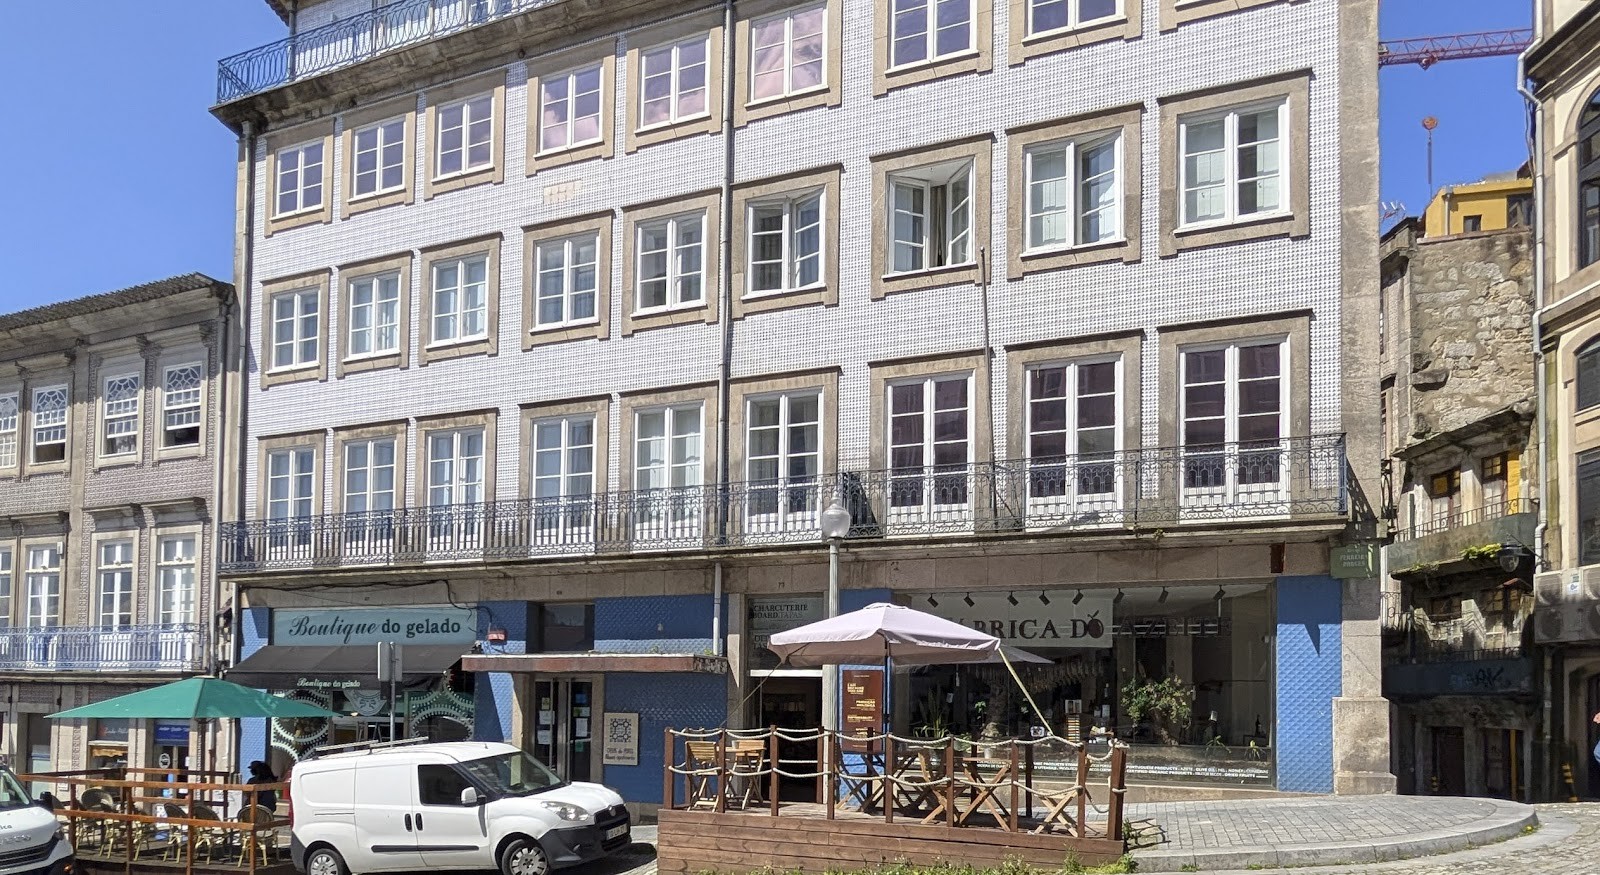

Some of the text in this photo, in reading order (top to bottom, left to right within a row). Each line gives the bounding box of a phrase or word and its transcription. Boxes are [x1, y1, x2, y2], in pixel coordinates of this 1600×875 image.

[754, 604, 809, 612] CHARCUTERIE
[288, 615, 461, 644] Boutique do gelado
[296, 677, 332, 690] Boutique
